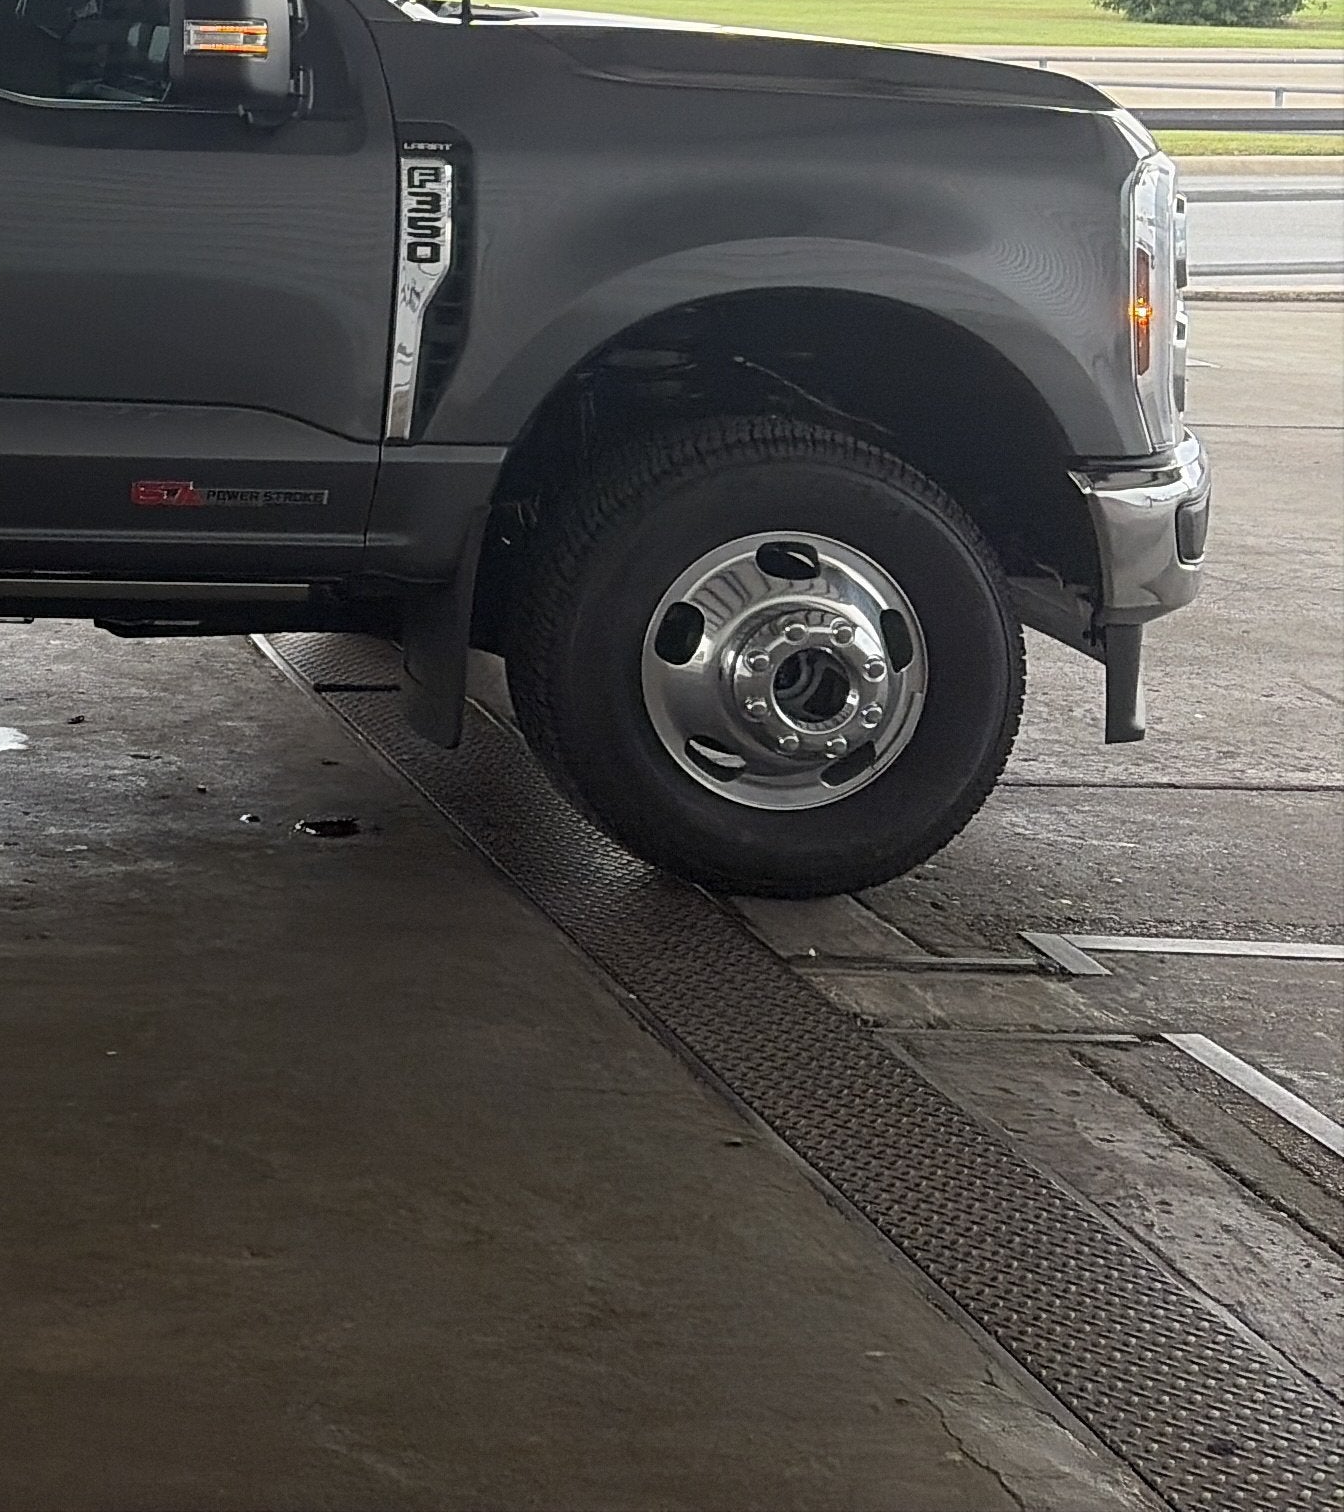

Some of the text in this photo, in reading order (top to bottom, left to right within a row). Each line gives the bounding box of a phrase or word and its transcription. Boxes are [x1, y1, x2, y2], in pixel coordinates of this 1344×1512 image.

[404, 142, 452, 150] LARIAT
[206, 490, 258, 502] POWER
[263, 490, 323, 503] STROKE
